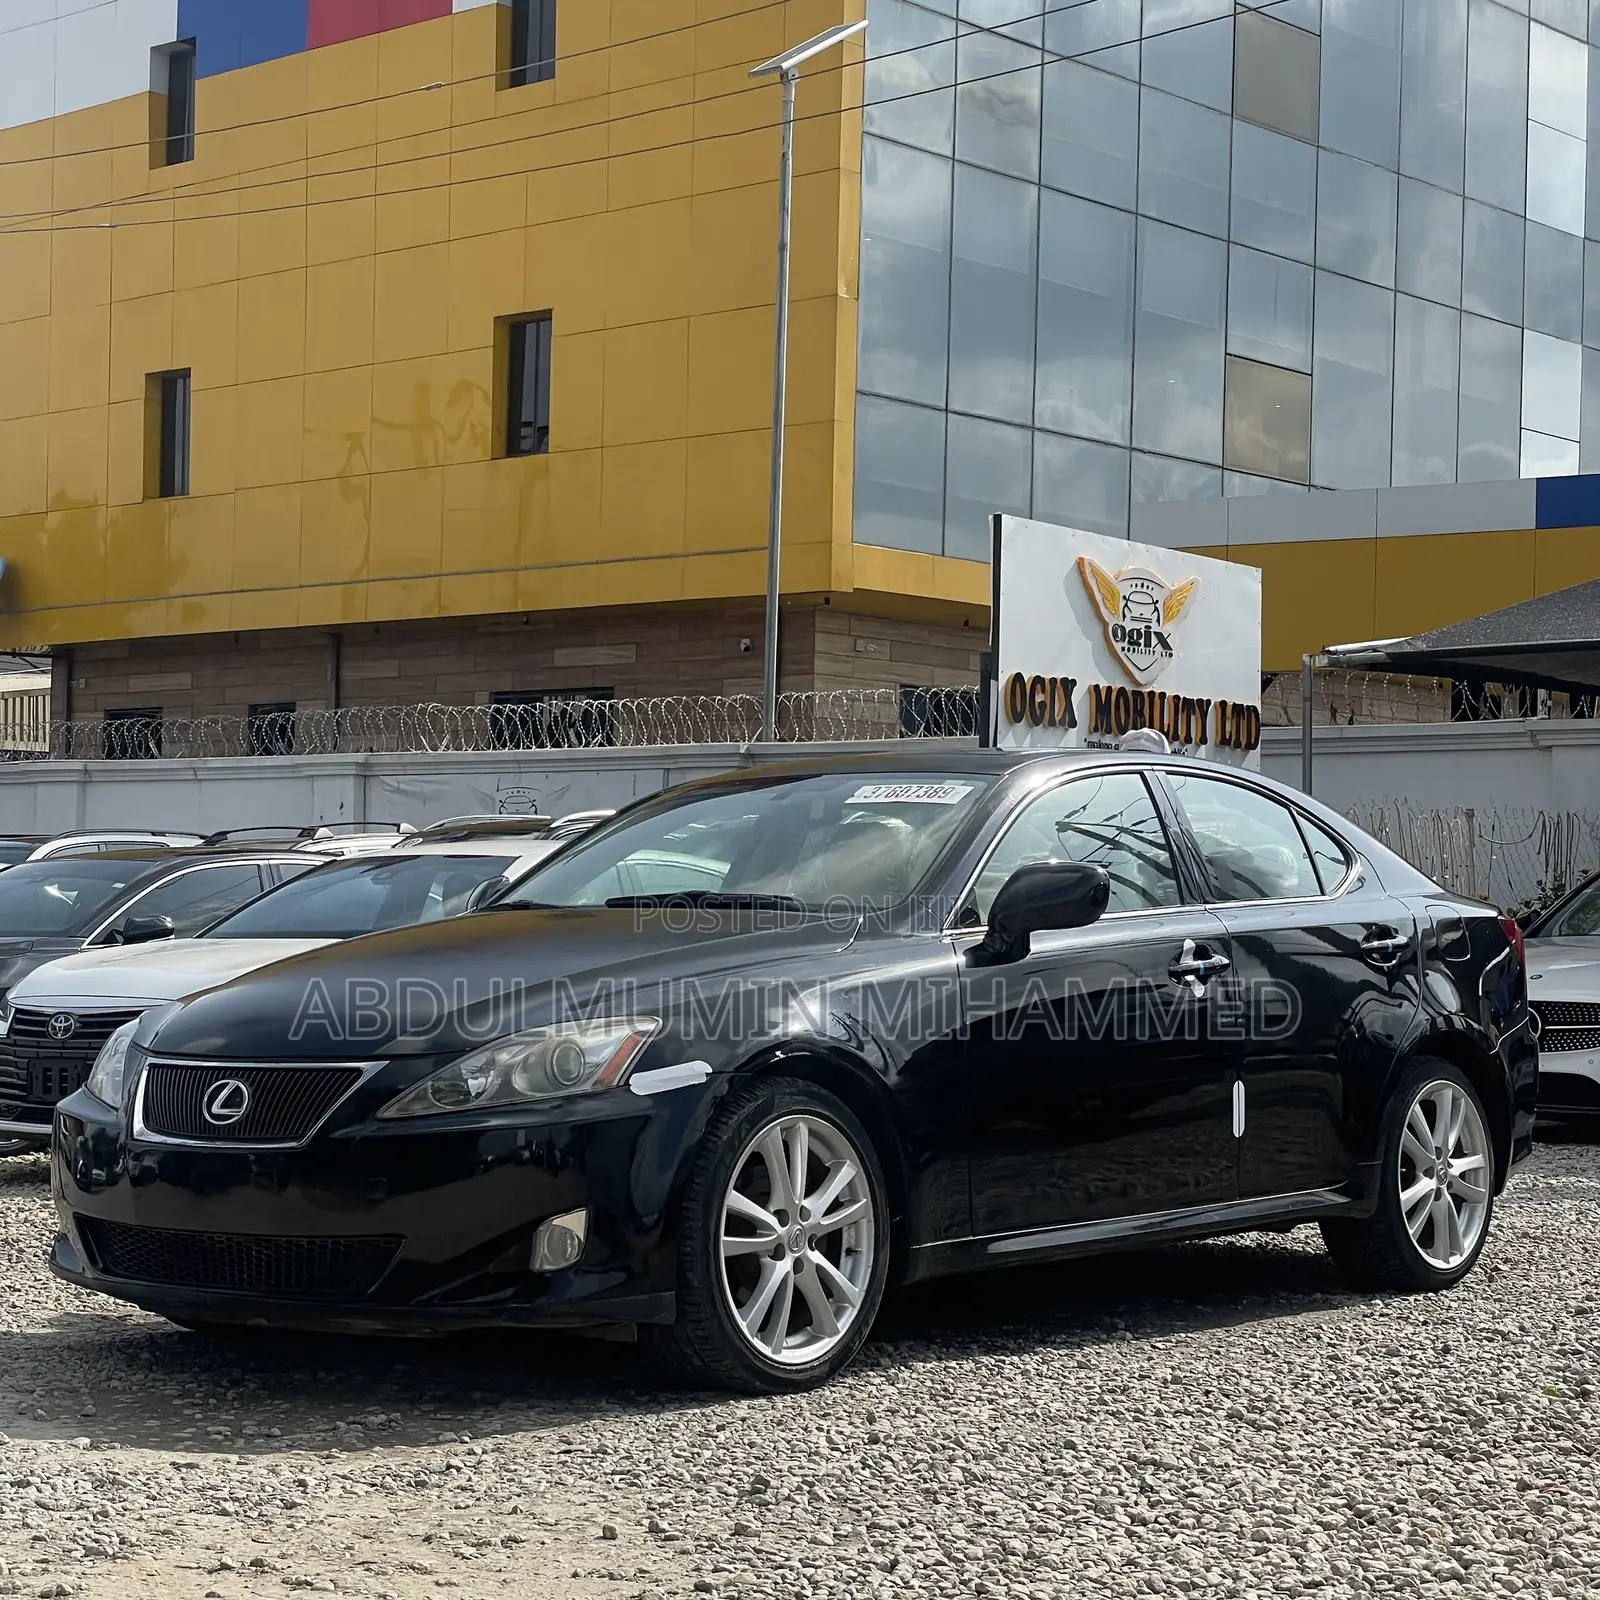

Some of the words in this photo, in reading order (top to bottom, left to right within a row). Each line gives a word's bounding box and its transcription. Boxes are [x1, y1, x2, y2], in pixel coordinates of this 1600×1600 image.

[1121, 646, 1156, 656] MOBILITY
[1004, 671, 1078, 729] OGIX
[1088, 683, 1212, 746] MOBILITY
[1214, 699, 1261, 751] LTD
